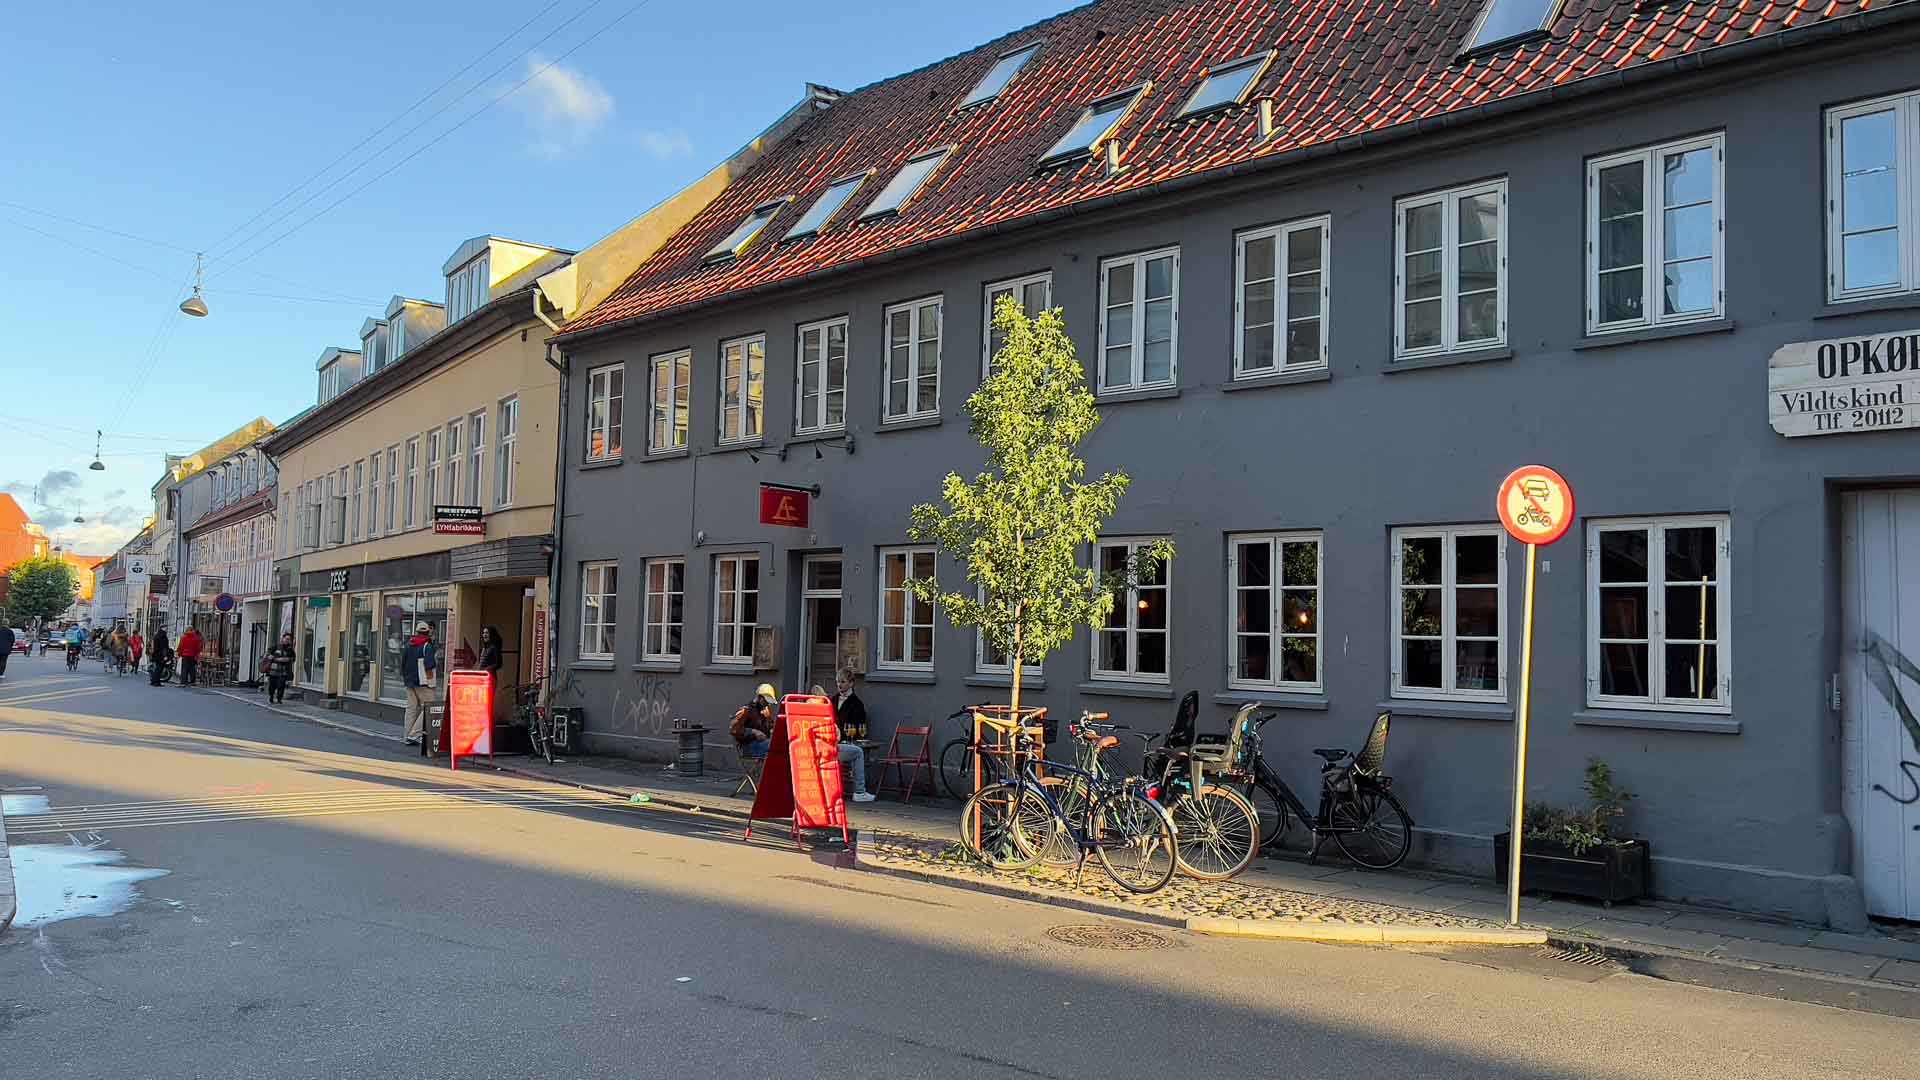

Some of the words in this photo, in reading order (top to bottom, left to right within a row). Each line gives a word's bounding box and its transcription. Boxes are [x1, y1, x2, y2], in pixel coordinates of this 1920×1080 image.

[1780, 383, 1905, 414] Vildtskind
[1813, 412, 1843, 430] Tlf.
[1851, 406, 1905, 428] 20112
